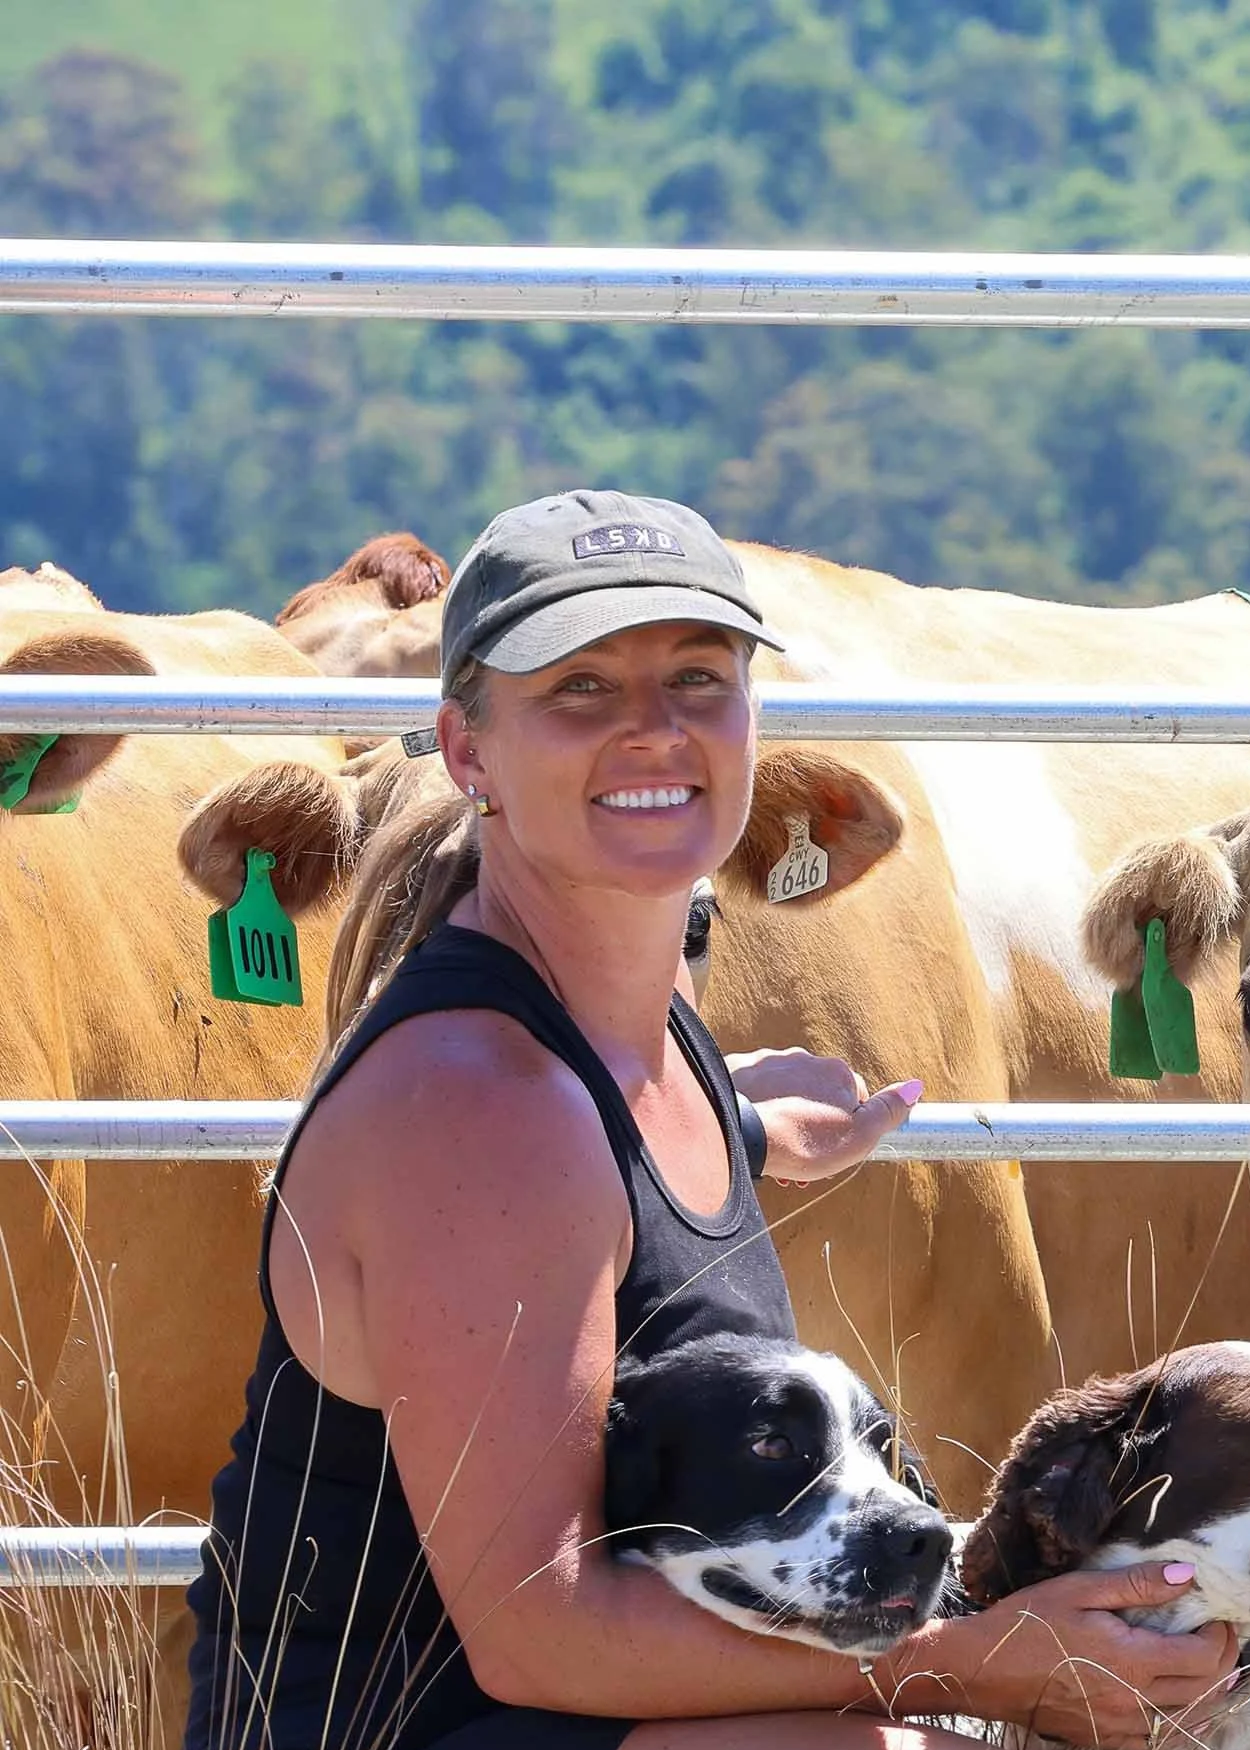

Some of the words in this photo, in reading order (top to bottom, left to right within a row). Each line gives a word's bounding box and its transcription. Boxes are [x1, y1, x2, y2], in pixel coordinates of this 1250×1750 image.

[789, 847, 809, 864] CWY
[782, 857, 819, 895] 646
[239, 926, 292, 982] 1011
